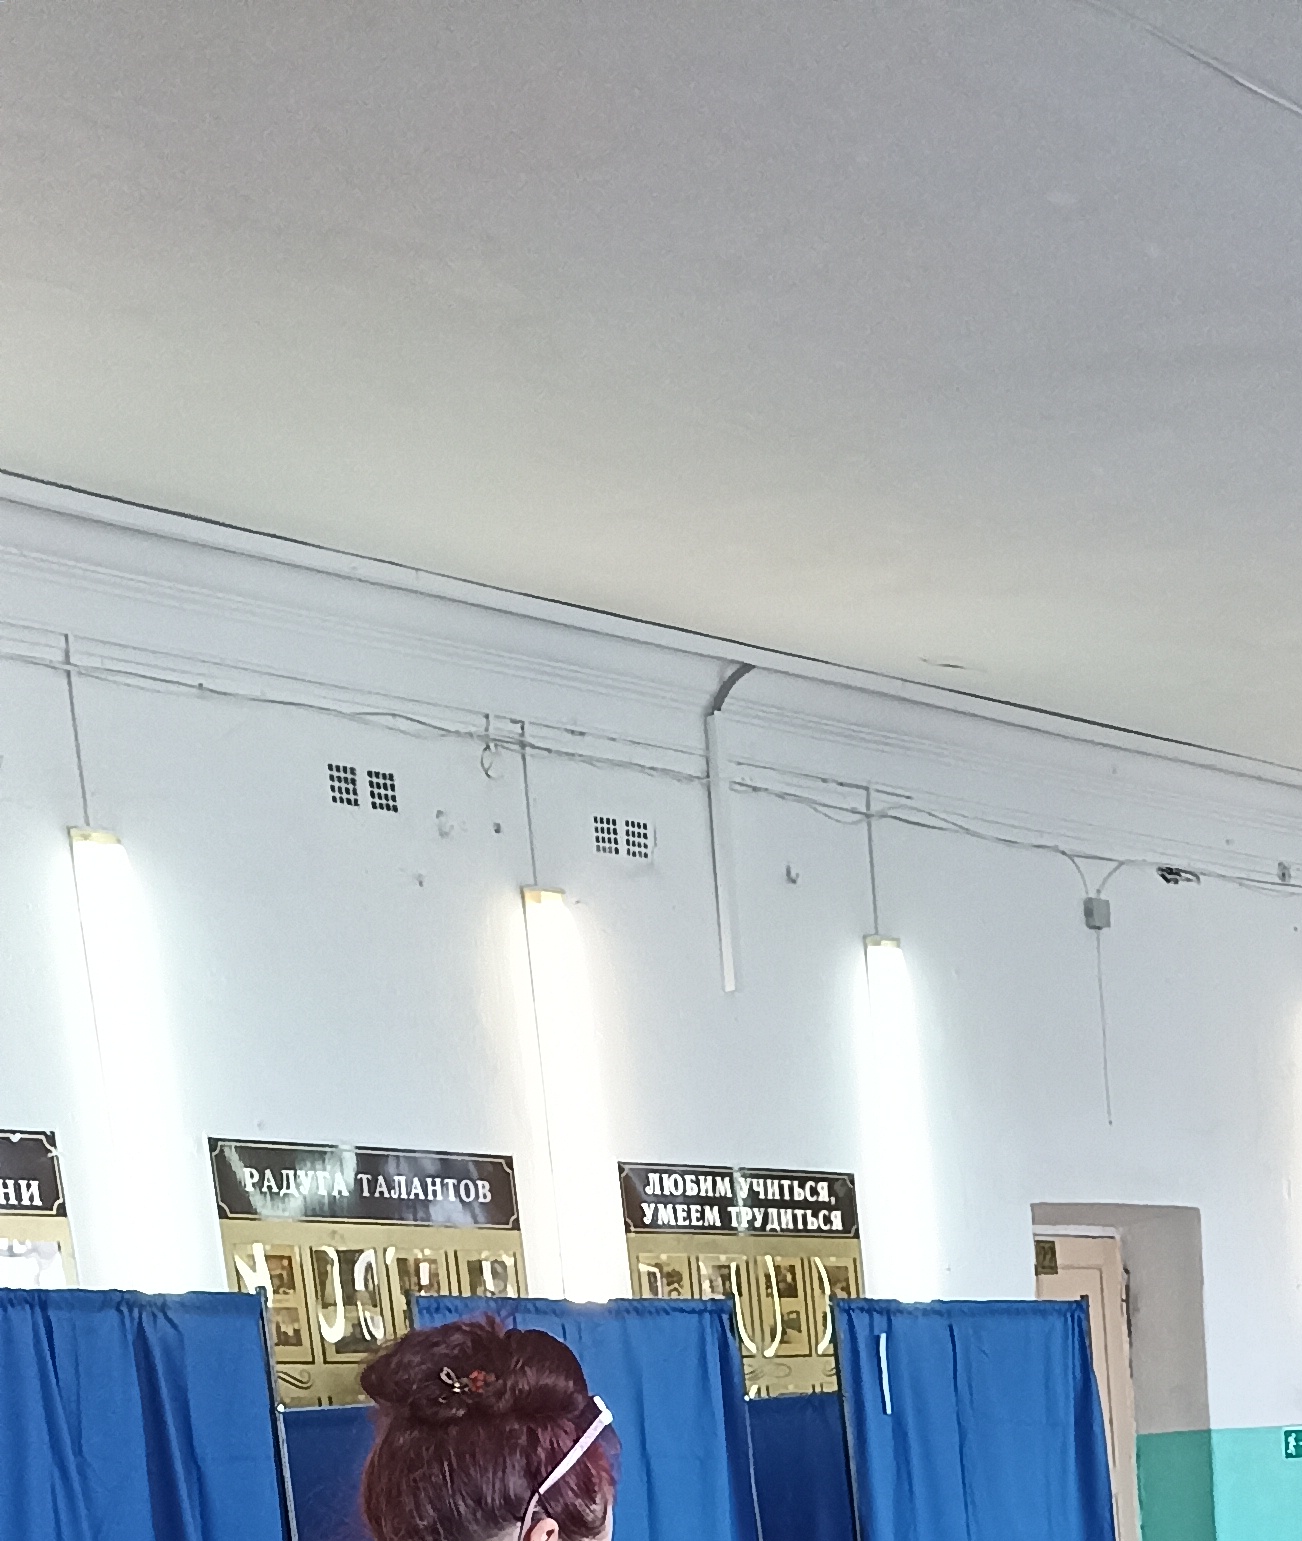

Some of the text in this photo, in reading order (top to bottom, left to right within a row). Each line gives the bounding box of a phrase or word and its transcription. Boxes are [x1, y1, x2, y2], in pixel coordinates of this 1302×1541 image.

[242, 1166, 492, 1203] РАДУГА ТАЛАНТОВ
[644, 1172, 836, 1205] ЛЮБИМ УЧИТЬСЯ,
[640, 1202, 843, 1233] УМЕЕМ ТРУДИТЬСЯ
